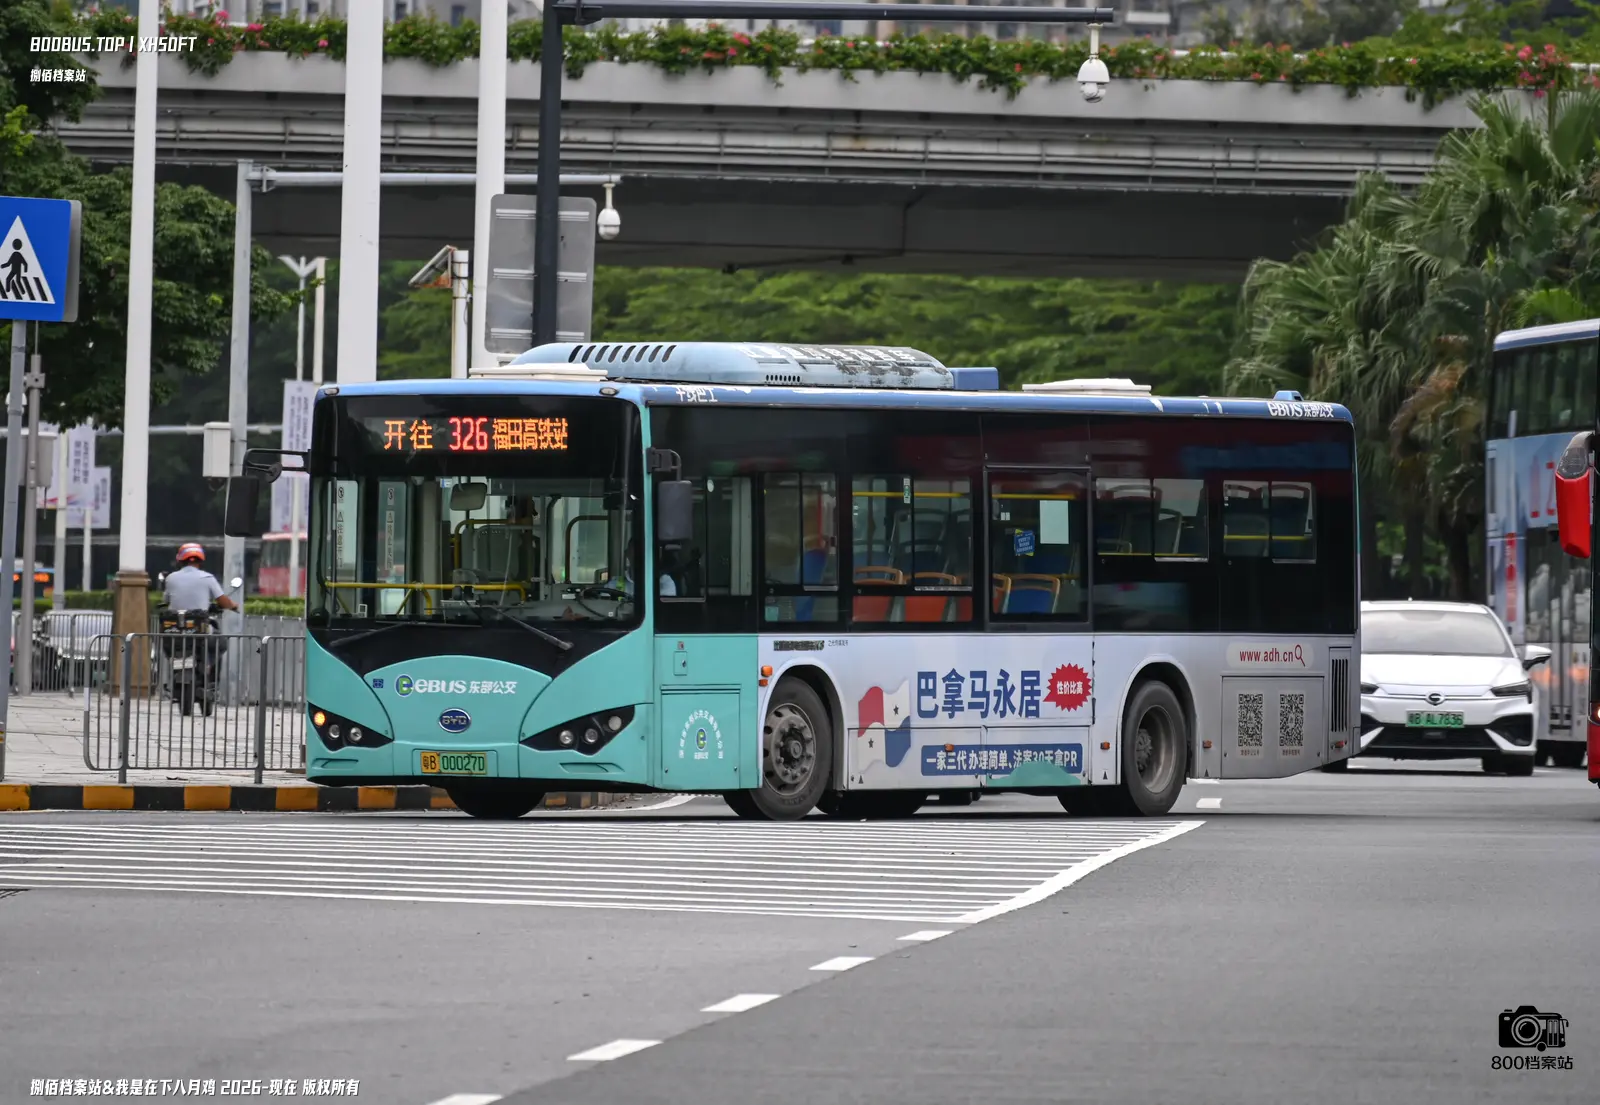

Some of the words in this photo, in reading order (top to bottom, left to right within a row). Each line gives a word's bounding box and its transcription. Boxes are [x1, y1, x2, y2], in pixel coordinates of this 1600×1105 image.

[384, 419, 433, 450] 开往
[449, 417, 488, 451] 326
[492, 417, 569, 450] 福田高铁站
[1239, 648, 1294, 662] www.adh.cn
[414, 679, 467, 694] eBUS
[468, 681, 518, 695] 东部公交
[916, 668, 1042, 720] 巴拿马永居
[1056, 680, 1084, 695] 性价比高
[442, 714, 468, 725] BYD
